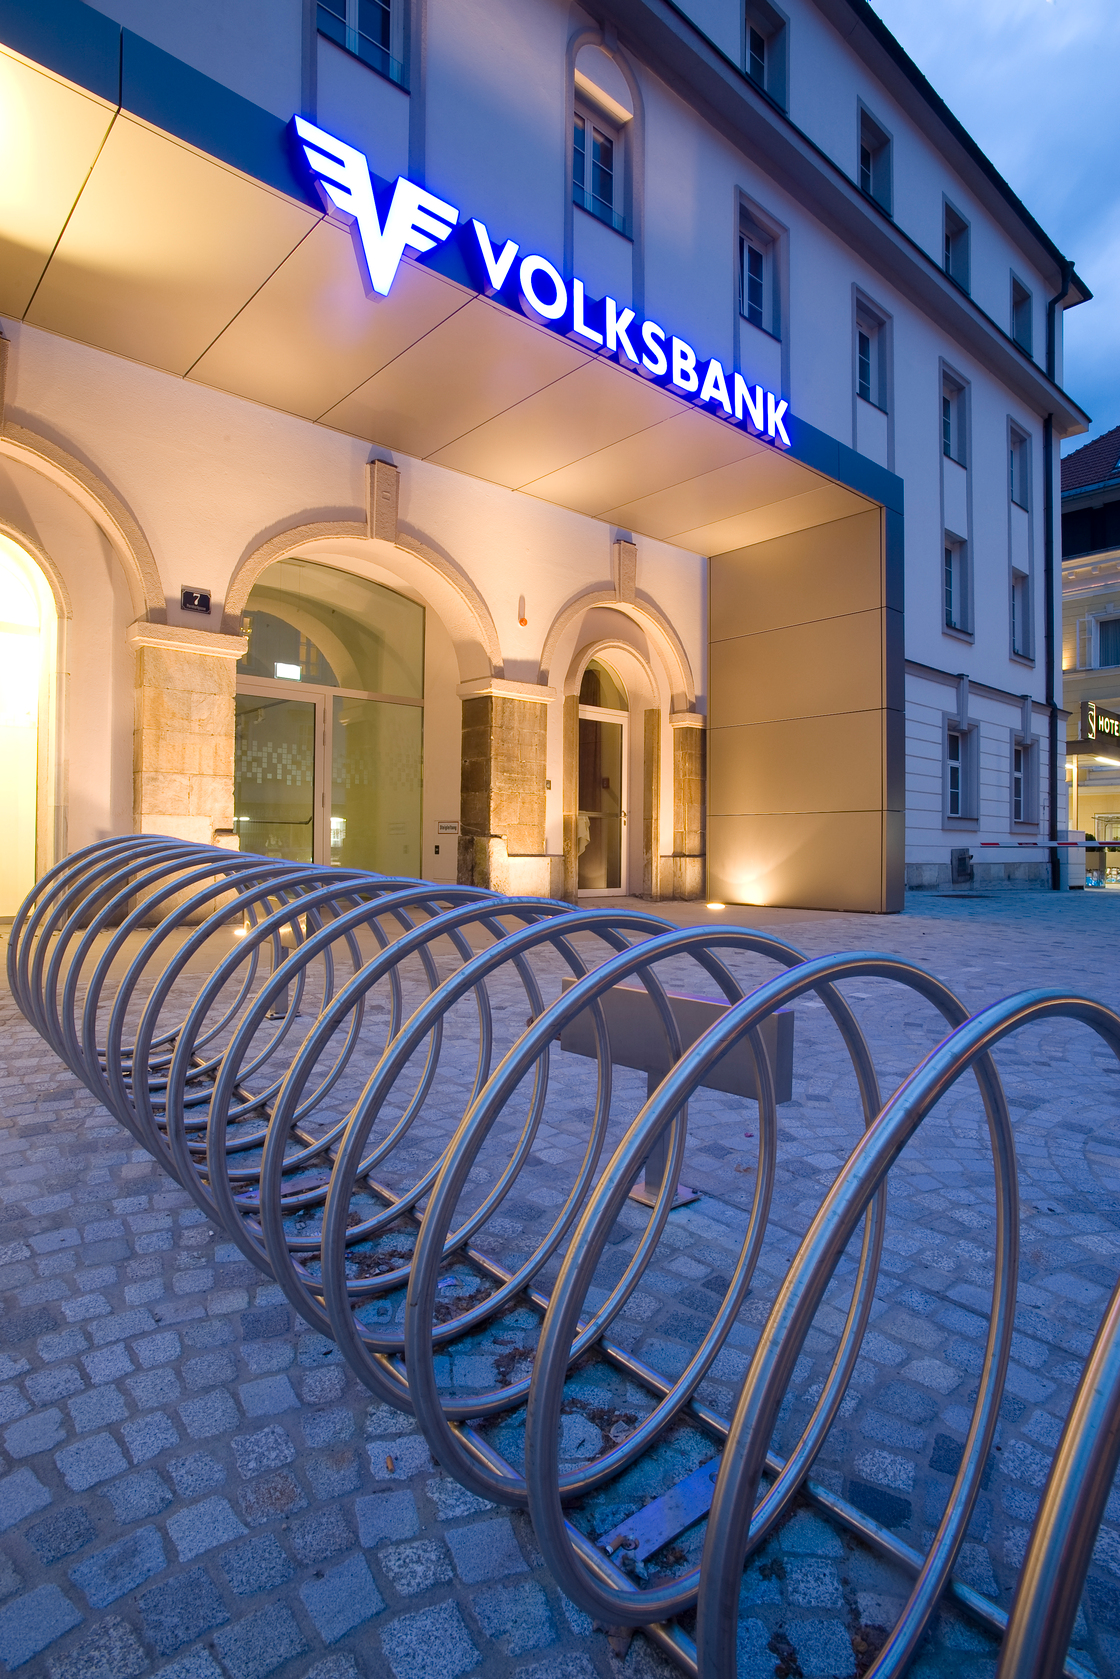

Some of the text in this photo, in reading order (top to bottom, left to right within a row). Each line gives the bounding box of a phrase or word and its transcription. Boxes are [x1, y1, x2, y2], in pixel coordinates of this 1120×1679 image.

[472, 217, 791, 447] VOLKSBANK
[193, 593, 201, 605] 7
[1098, 715, 1120, 737] HOTE
